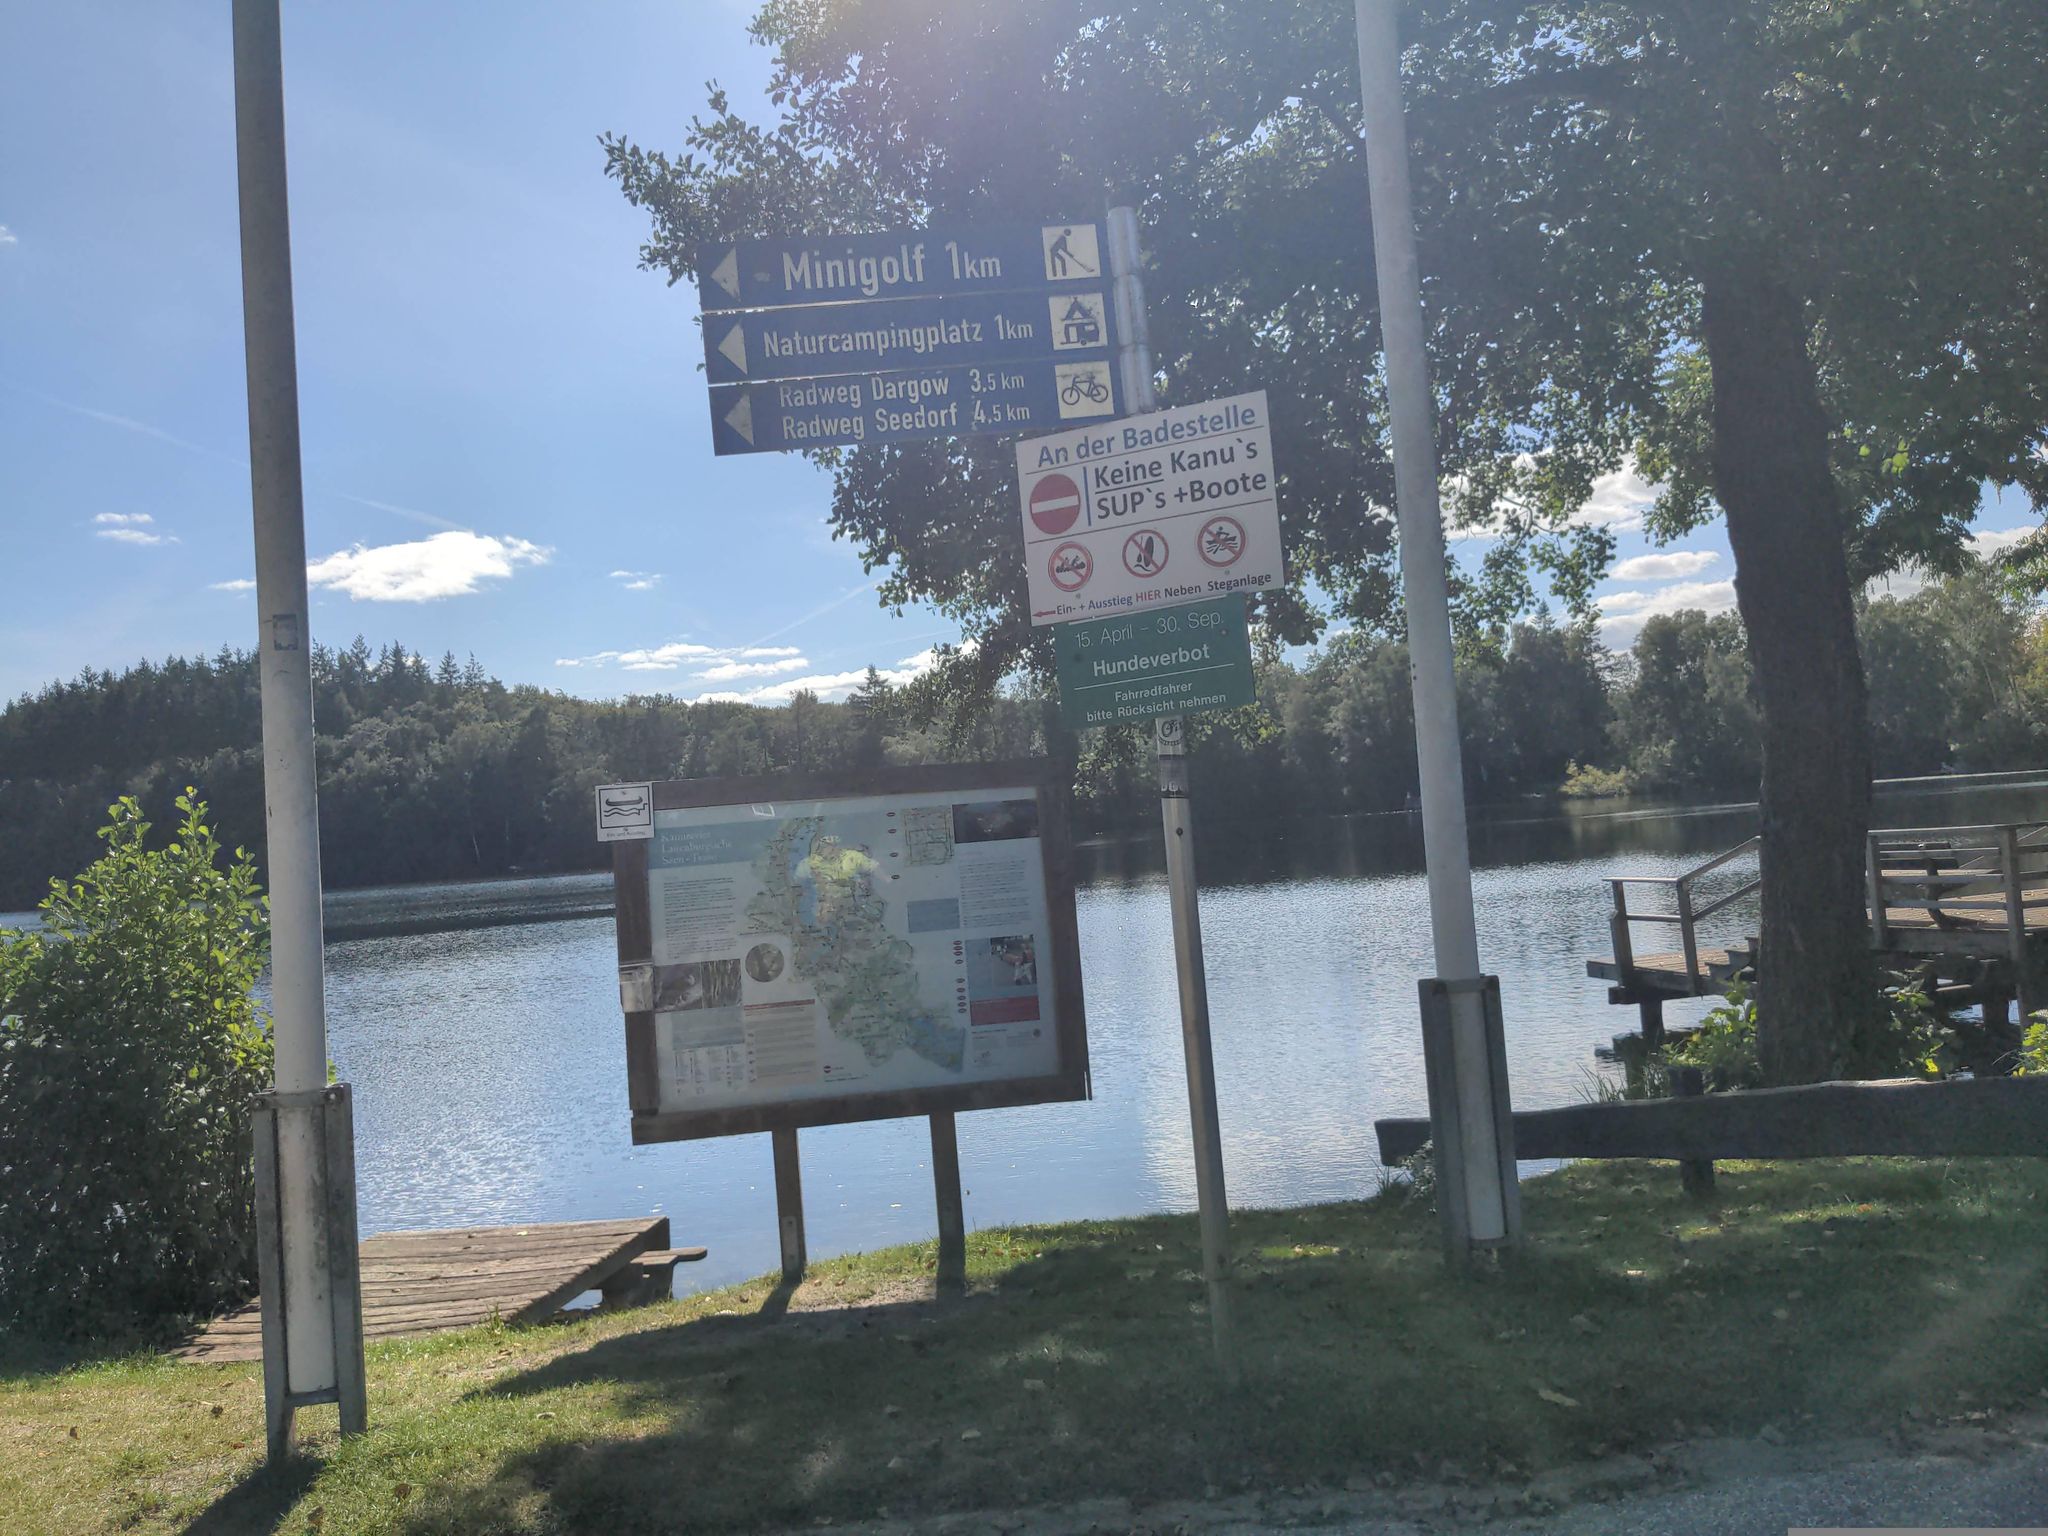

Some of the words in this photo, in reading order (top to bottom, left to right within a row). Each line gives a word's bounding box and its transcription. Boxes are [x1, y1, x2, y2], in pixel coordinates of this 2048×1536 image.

[783, 243, 925, 296] Minigolf
[763, 317, 983, 358] Naturcampingplatz
[779, 383, 862, 408] Radweg
[871, 376, 949, 404] Dargow
[1001, 372, 1025, 390] km
[782, 414, 865, 440] Radweg
[875, 402, 957, 432] Seedorf
[1006, 403, 1030, 421] km
[1038, 445, 1069, 467] An
[1076, 436, 1115, 460] der
[1123, 404, 1256, 450] Badestelle
[1095, 461, 1162, 488] Keine
[1056, 604, 1076, 615] Ein-
[1088, 595, 1133, 610] Ausstieg
[1136, 590, 1161, 602] HIER
[1164, 583, 1201, 598] Neben
[1207, 573, 1272, 592] Steganlage
[1075, 631, 1094, 648] 15.
[1100, 624, 1133, 646] April
[1157, 616, 1181, 634] 30.
[1188, 612, 1224, 631] Sep.
[1093, 643, 1210, 676] Hundeverbot
[1086, 709, 1113, 722] bitte
[1117, 701, 1175, 717] Rücksicht
[1179, 693, 1226, 708] nehmen
[1115, 682, 1193, 702] Fahrradfahrer
